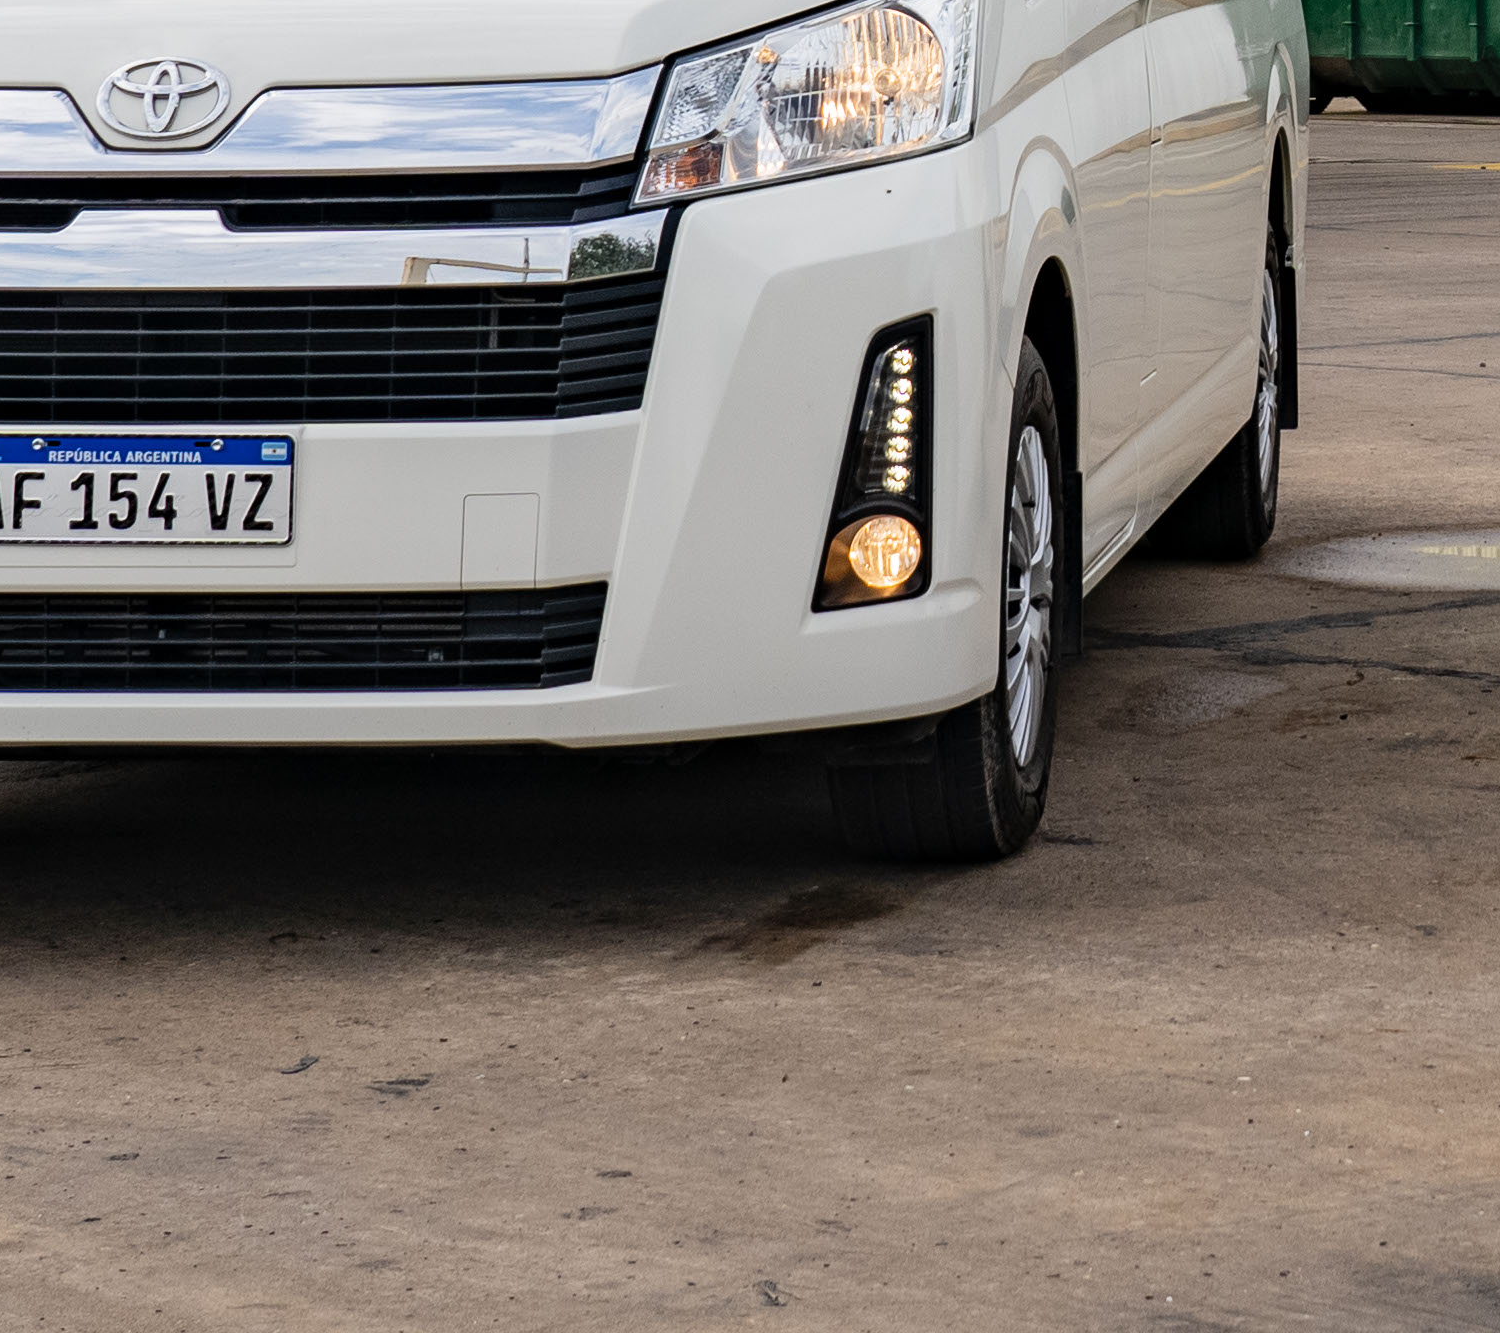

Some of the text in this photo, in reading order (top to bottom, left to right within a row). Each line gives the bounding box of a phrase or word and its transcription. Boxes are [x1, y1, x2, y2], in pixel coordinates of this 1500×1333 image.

[48, 447, 202, 463] REPÚBLICA ARGENTINA
[69, 471, 177, 530] 154
[205, 473, 274, 531] VZ
